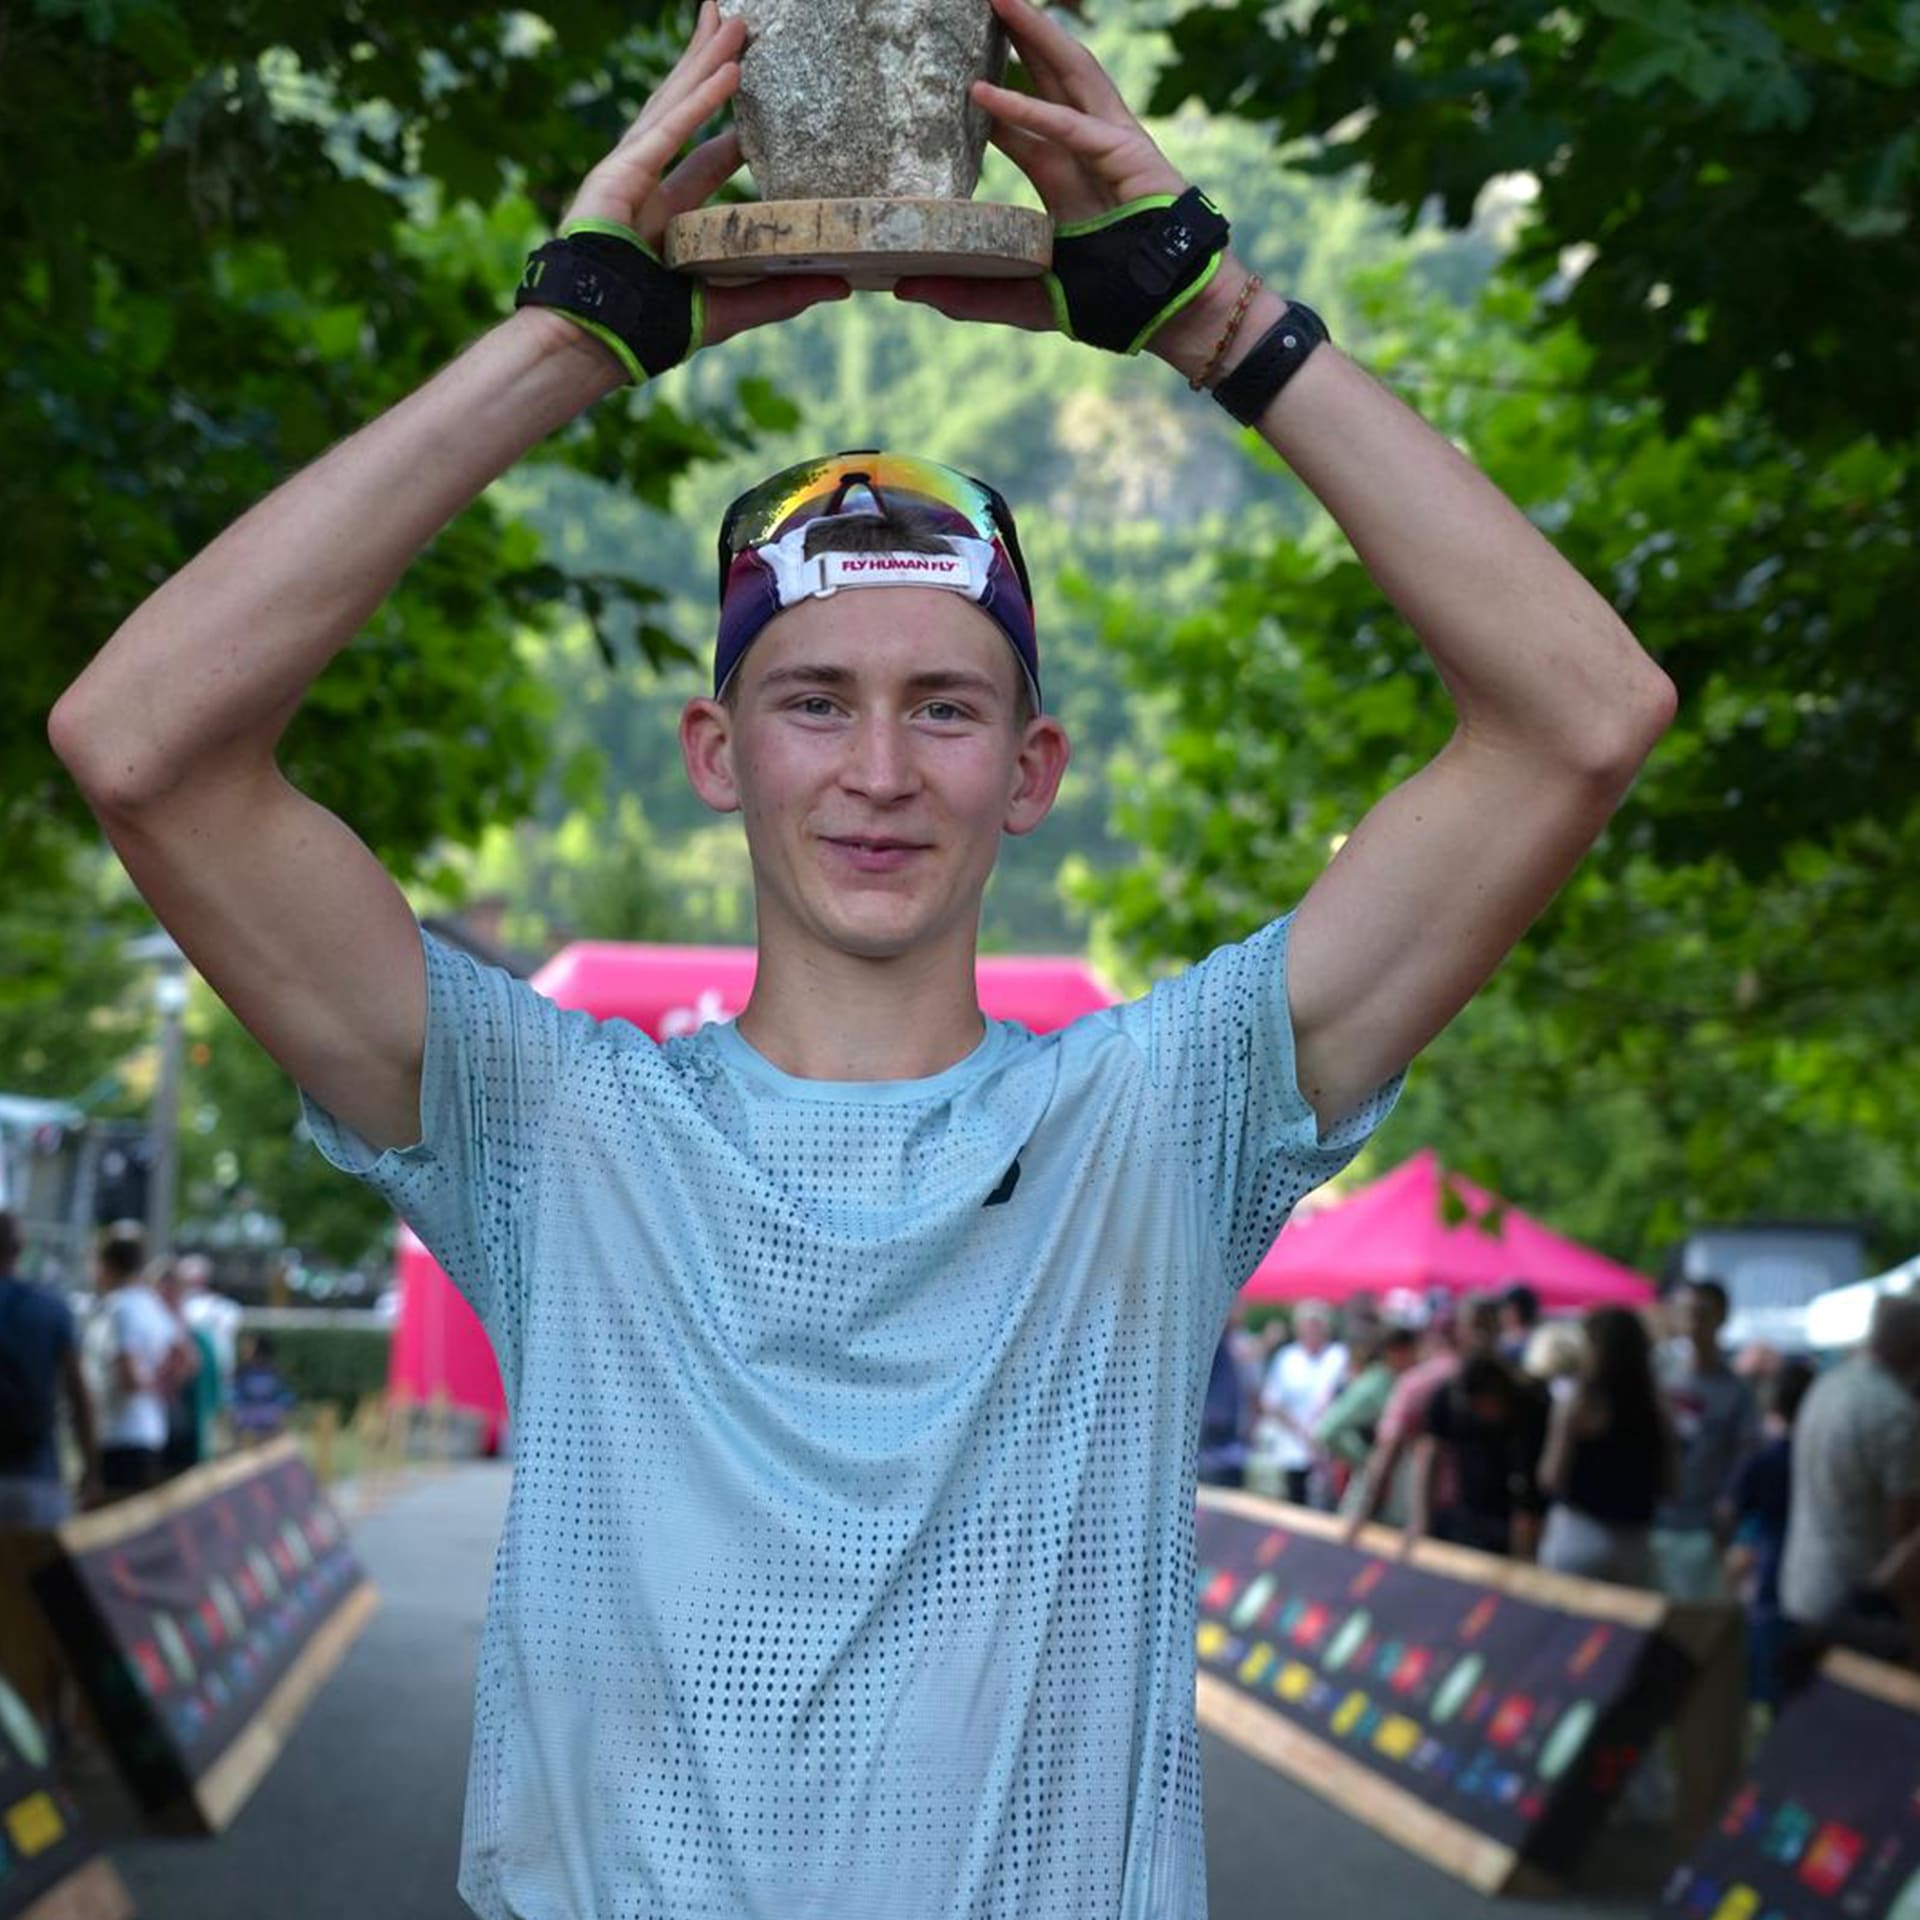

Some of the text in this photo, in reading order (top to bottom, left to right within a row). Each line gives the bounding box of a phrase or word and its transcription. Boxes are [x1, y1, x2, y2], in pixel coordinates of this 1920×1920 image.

[842, 560, 956, 572] FLY HUMAN FLY
